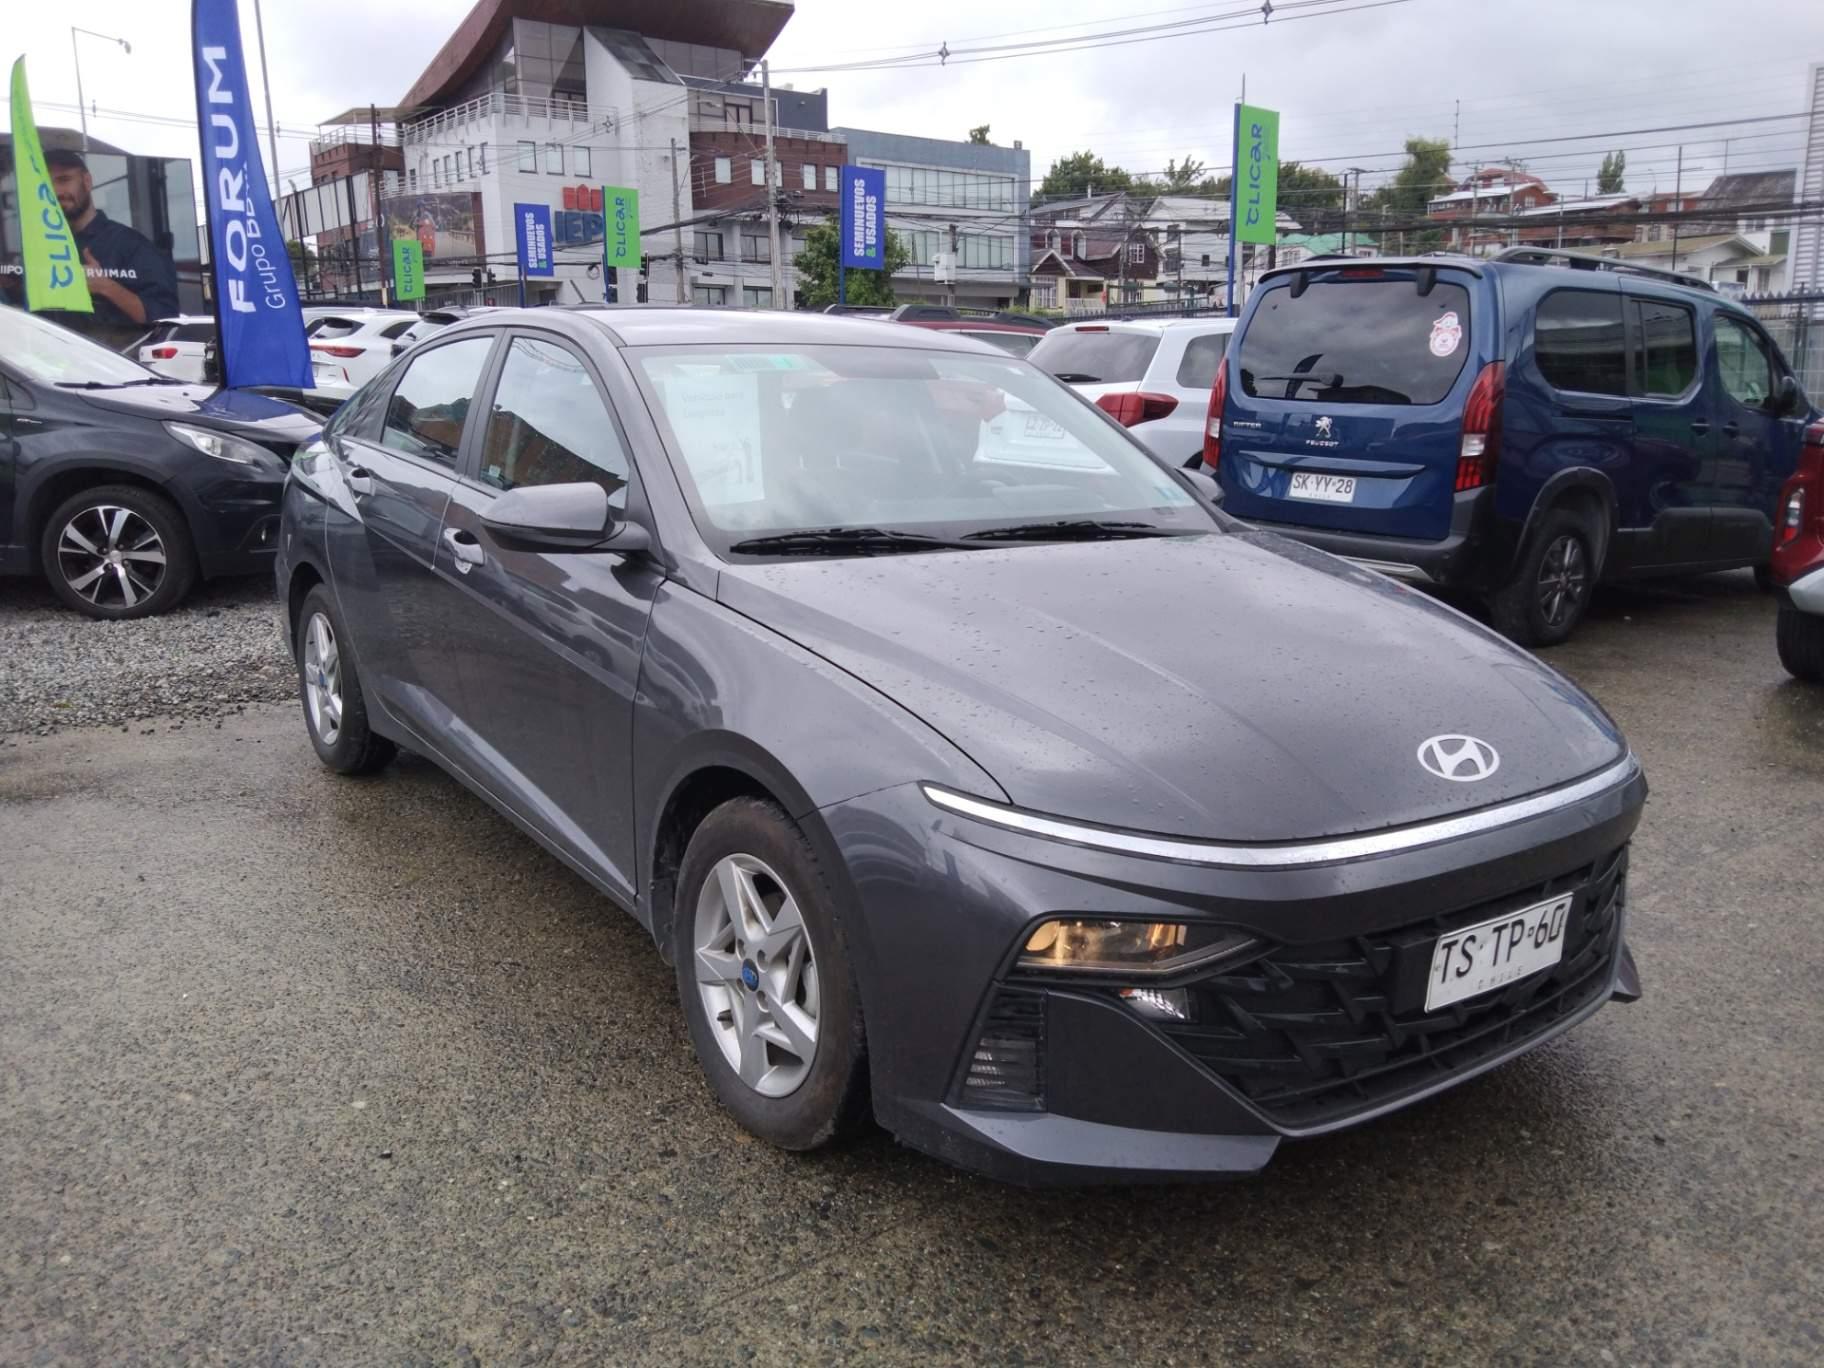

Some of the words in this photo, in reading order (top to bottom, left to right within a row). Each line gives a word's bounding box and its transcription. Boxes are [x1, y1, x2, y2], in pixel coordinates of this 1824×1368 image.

[202, 46, 257, 312] FORUM
[525, 212, 538, 269] SEMINUEVOS
[535, 224, 547, 259] USADOS
[854, 178, 866, 257] SEMINUEVOS
[866, 195, 877, 245] USADOS
[250, 244, 286, 310] Grupo
[866, 246, 877, 257] &
